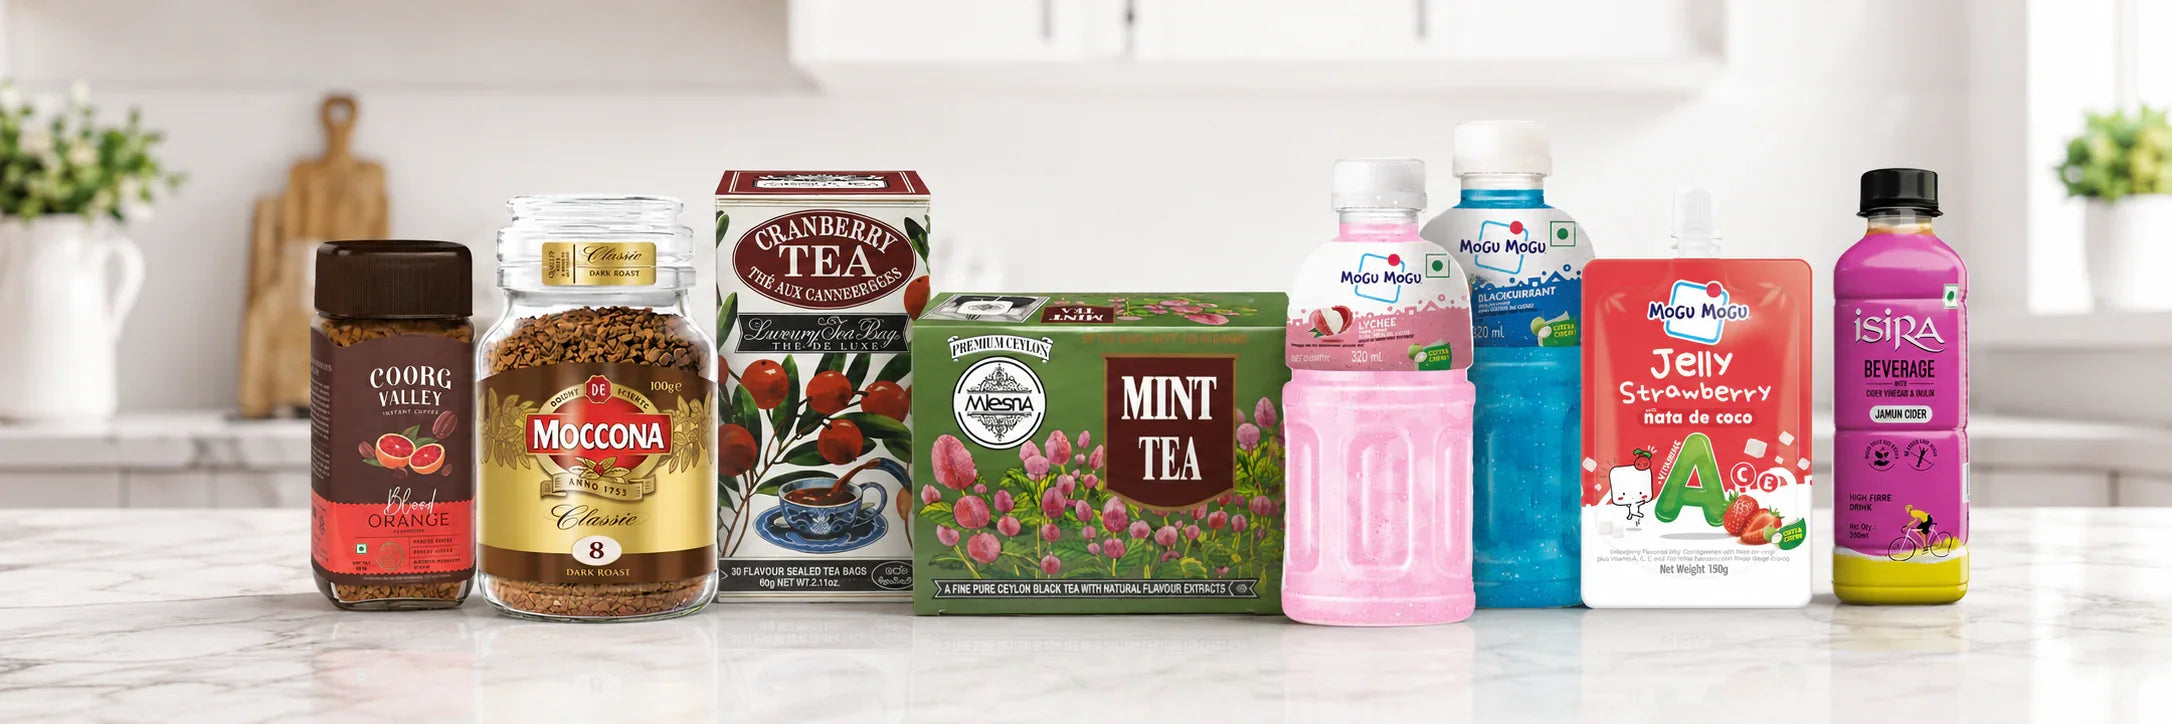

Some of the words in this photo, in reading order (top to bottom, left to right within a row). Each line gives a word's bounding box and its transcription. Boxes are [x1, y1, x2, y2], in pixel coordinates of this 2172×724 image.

[754, 215, 899, 255] CRANBERRY
[583, 246, 642, 264] Classic
[778, 244, 876, 277] TEA
[774, 281, 804, 300] AUX
[1358, 317, 1397, 330] LYCHEE
[813, 342, 832, 350] DE
[840, 342, 879, 350] LUXE
[952, 337, 1004, 356] PREMIUM
[1006, 337, 1049, 357] CEYLON
[1351, 350, 1368, 363] 320
[1650, 348, 1733, 379] Jelly
[370, 366, 452, 390] COORG
[1864, 360, 1935, 378] BEVERAGE
[379, 390, 442, 407] VALLEY
[592, 384, 606, 396] DE
[1121, 376, 1218, 420] MINT
[1619, 381, 1772, 405] Strawberry
[1689, 409, 1710, 424] de
[1716, 412, 1753, 424] coco
[1875, 409, 1903, 419] JAMUN
[1905, 409, 1927, 419] CIDER
[533, 419, 665, 450] MOCCONA
[1138, 436, 1203, 481] TEA
[1654, 432, 1726, 527] A
[1737, 467, 1748, 483] C
[1763, 476, 1774, 490] E
[568, 477, 599, 491] ANNO
[603, 484, 628, 497] 1753
[368, 512, 449, 528] ORANGE
[550, 504, 638, 531] Classic
[589, 541, 604, 559] 8
[566, 569, 594, 577] DARK
[597, 569, 630, 577] ROAST
[731, 567, 741, 576] 30
[743, 567, 785, 576] FLAVOUR
[786, 567, 821, 576] SEALED
[823, 567, 840, 576] TEA
[842, 567, 867, 576] BAGS
[1660, 564, 1674, 574] Net
[1676, 564, 1705, 576] Weight
[1708, 564, 1729, 576] 150g
[777, 578, 795, 587] NET
[944, 584, 951, 594] A
[952, 584, 971, 594] FINE
[973, 584, 995, 594] PURE
[997, 584, 1031, 594] CEYLON
[1033, 584, 1061, 594] BLACK
[1064, 584, 1080, 594] TEA
[1081, 584, 1102, 594] WITH
[1103, 584, 1142, 594] NATURAL
[1143, 584, 1182, 594] FLAVOUR
[1183, 584, 1226, 594] EXTRACTS
